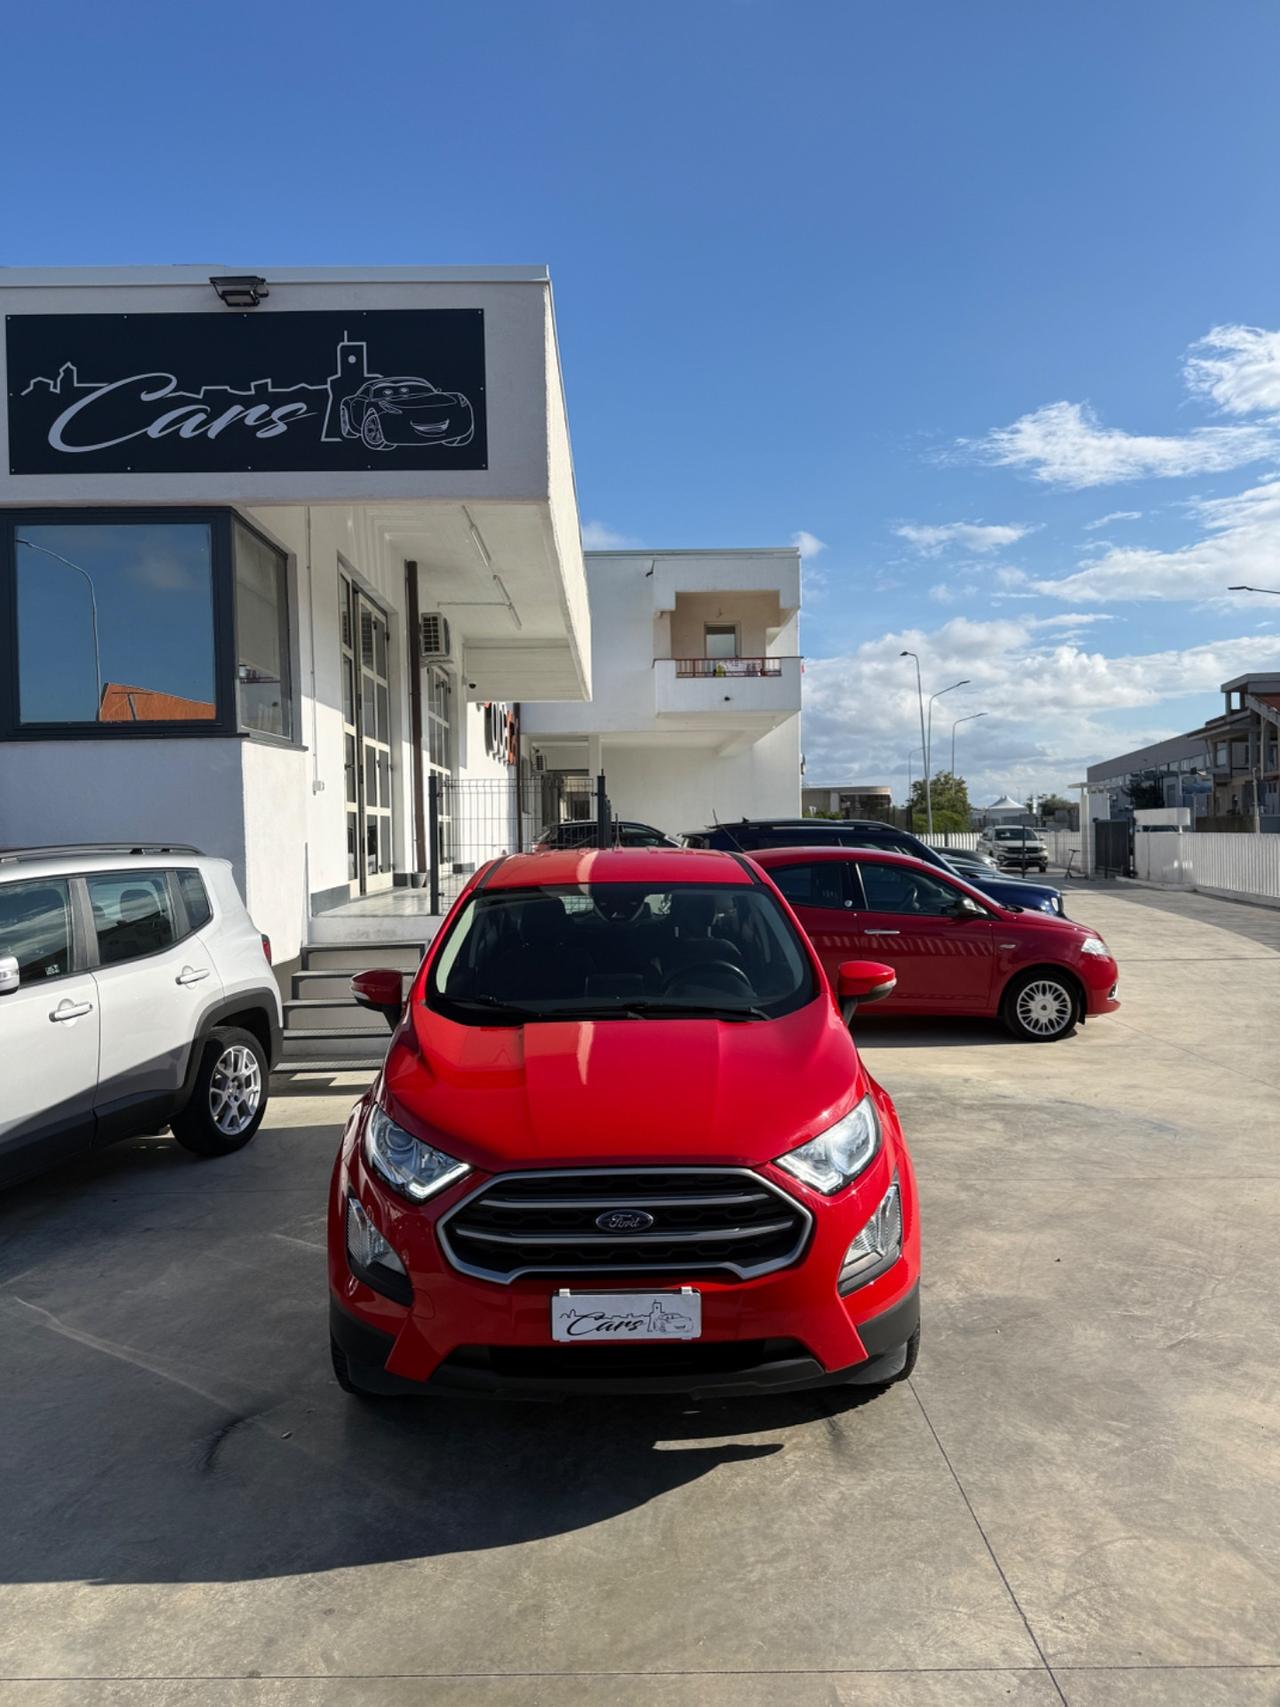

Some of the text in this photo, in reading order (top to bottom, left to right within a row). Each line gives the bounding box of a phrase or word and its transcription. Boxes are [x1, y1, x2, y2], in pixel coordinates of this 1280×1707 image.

[48, 373, 317, 453] Cars
[608, 1214, 641, 1228] Ford
[566, 1312, 644, 1336] Cars
